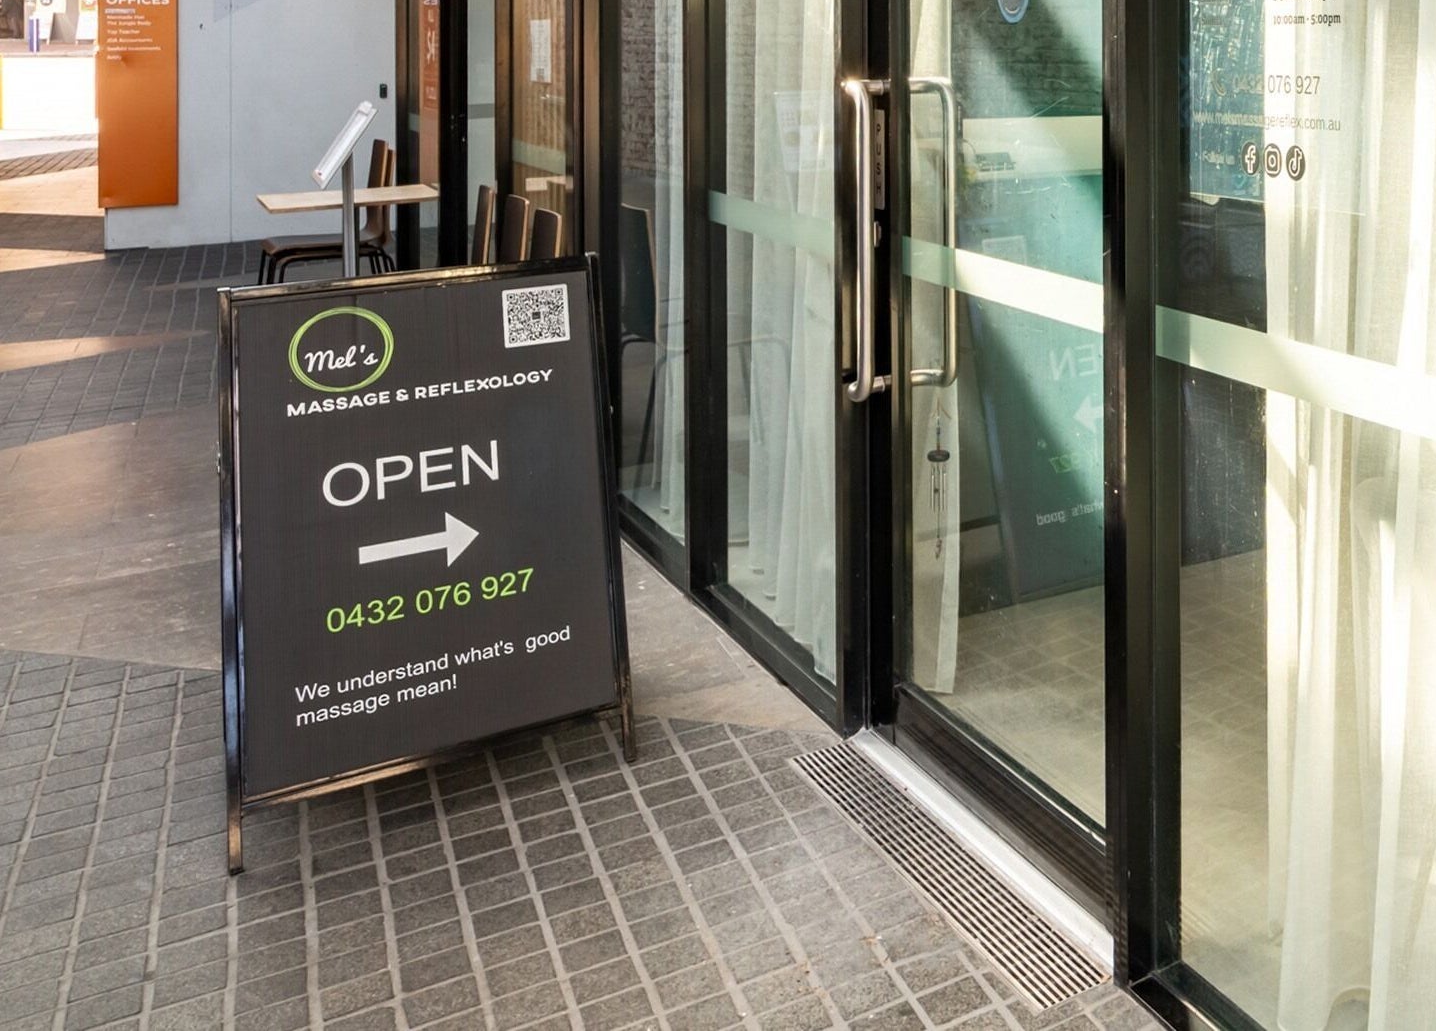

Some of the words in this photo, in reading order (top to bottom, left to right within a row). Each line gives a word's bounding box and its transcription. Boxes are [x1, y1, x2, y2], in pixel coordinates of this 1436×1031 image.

[1273, 15, 1305, 25] 10:00am
[1311, 13, 1341, 26] 5:00pm
[1267, 74, 1291, 94] 076
[1295, 75, 1321, 95] 927
[304, 344, 378, 372] Mel's
[287, 391, 391, 417] MASSAGE
[395, 389, 409, 402] &
[415, 369, 553, 400] REFLEXOLOGY
[322, 440, 500, 507] OPEN
[326, 595, 405, 633] 0432
[415, 581, 472, 614] 076
[481, 568, 534, 600] 927
[295, 683, 331, 703] We
[337, 653, 449, 694] understand
[454, 640, 514, 666] what's
[525, 625, 571, 653] good
[296, 692, 390, 727] massage
[397, 674, 457, 702] mean!
